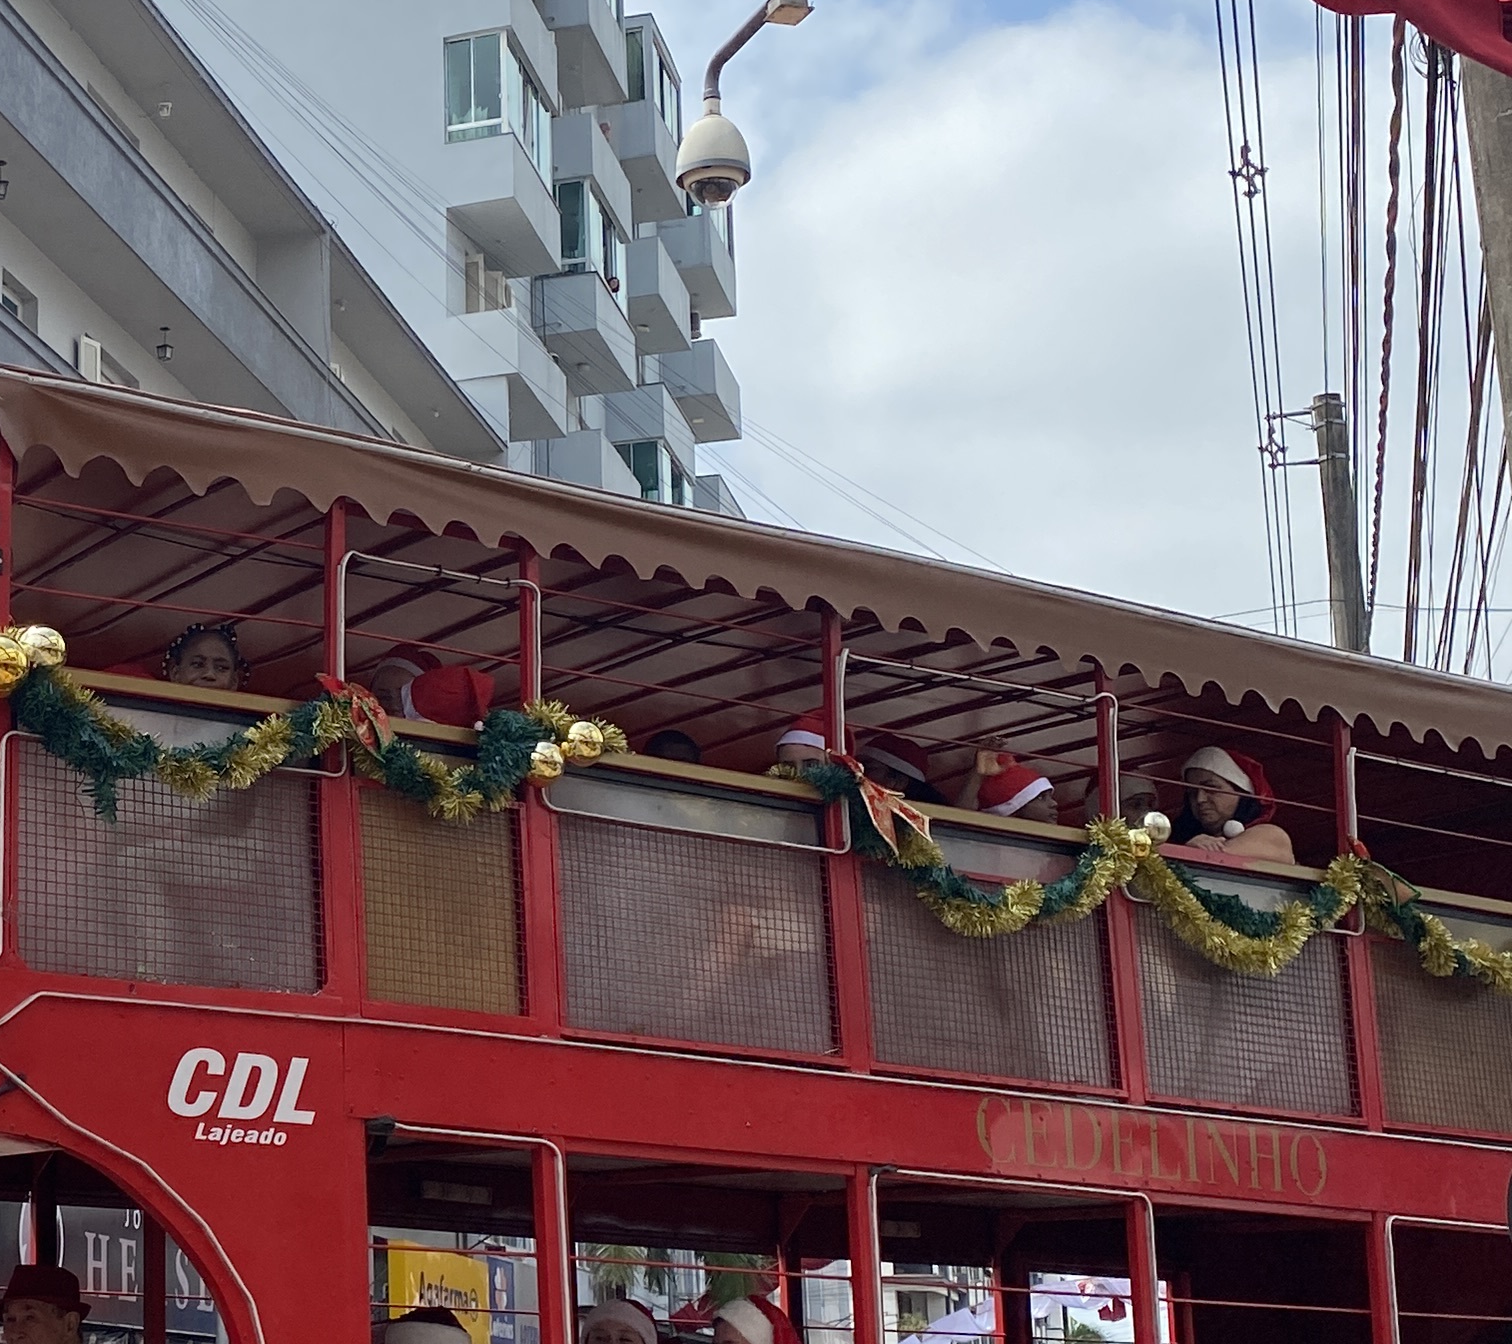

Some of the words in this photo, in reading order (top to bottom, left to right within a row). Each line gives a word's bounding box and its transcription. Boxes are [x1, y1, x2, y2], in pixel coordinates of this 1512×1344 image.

[167, 1047, 316, 1125] CDL
[195, 1122, 287, 1146] Lajeado
[975, 1096, 1328, 1197] CEDELINHO
